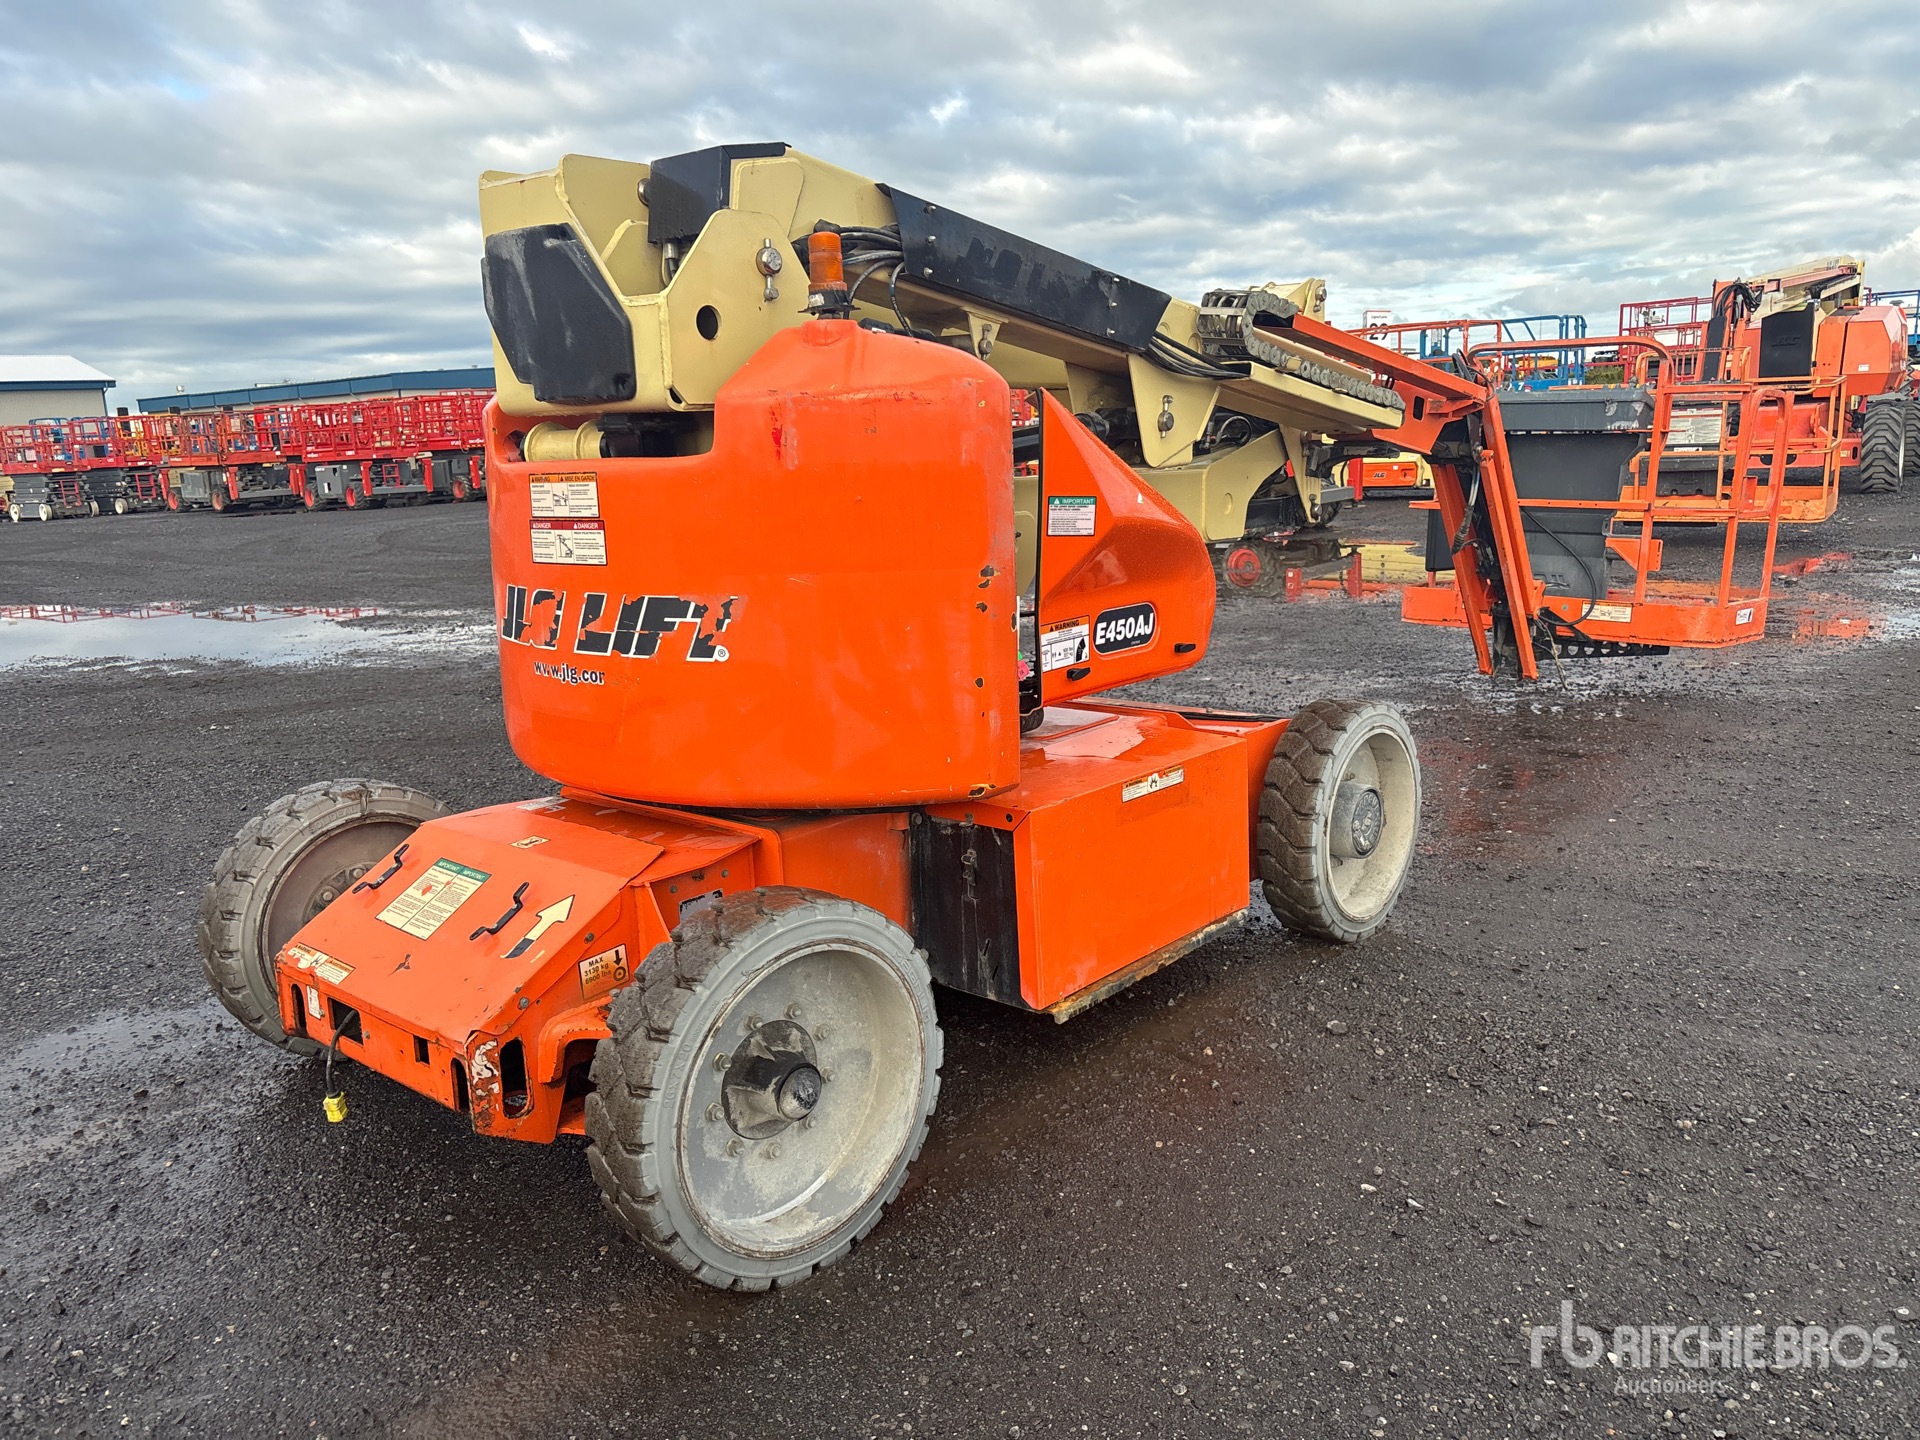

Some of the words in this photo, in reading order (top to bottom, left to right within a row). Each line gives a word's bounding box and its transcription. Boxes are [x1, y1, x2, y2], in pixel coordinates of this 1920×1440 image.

[1054, 620, 1080, 631] WARNING
[1095, 612, 1154, 646] E450AJ
[463, 869, 485, 880] IMPORTANT
[588, 956, 604, 967] MAX
[584, 966, 600, 977] 3130
[585, 974, 601, 985] 6900
